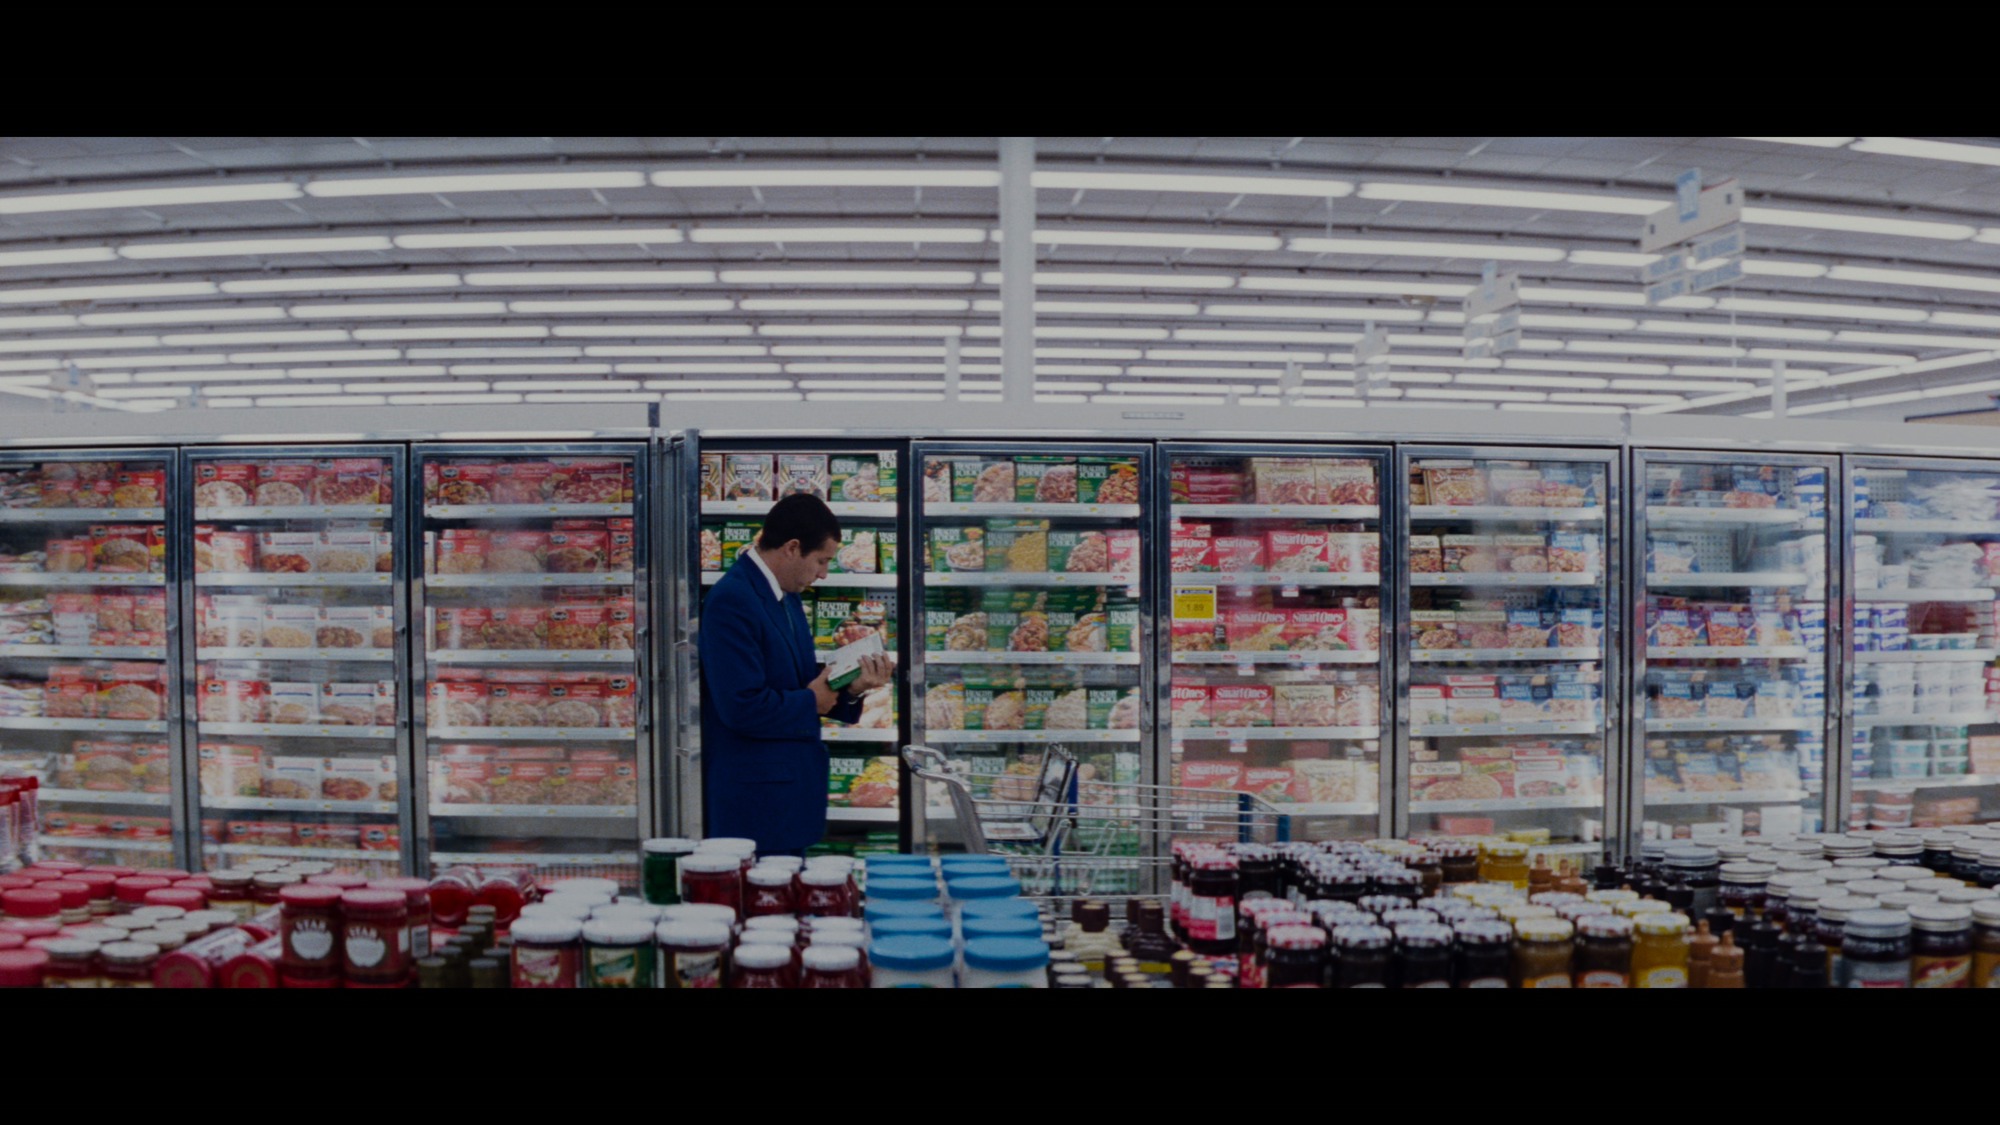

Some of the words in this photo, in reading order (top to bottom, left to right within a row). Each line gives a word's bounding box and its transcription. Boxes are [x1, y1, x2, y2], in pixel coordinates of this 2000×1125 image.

[817, 601, 851, 610] HEALTHY
[817, 610, 850, 618] CHOICE
[296, 919, 327, 932] STAR
[349, 927, 378, 939] STAR
